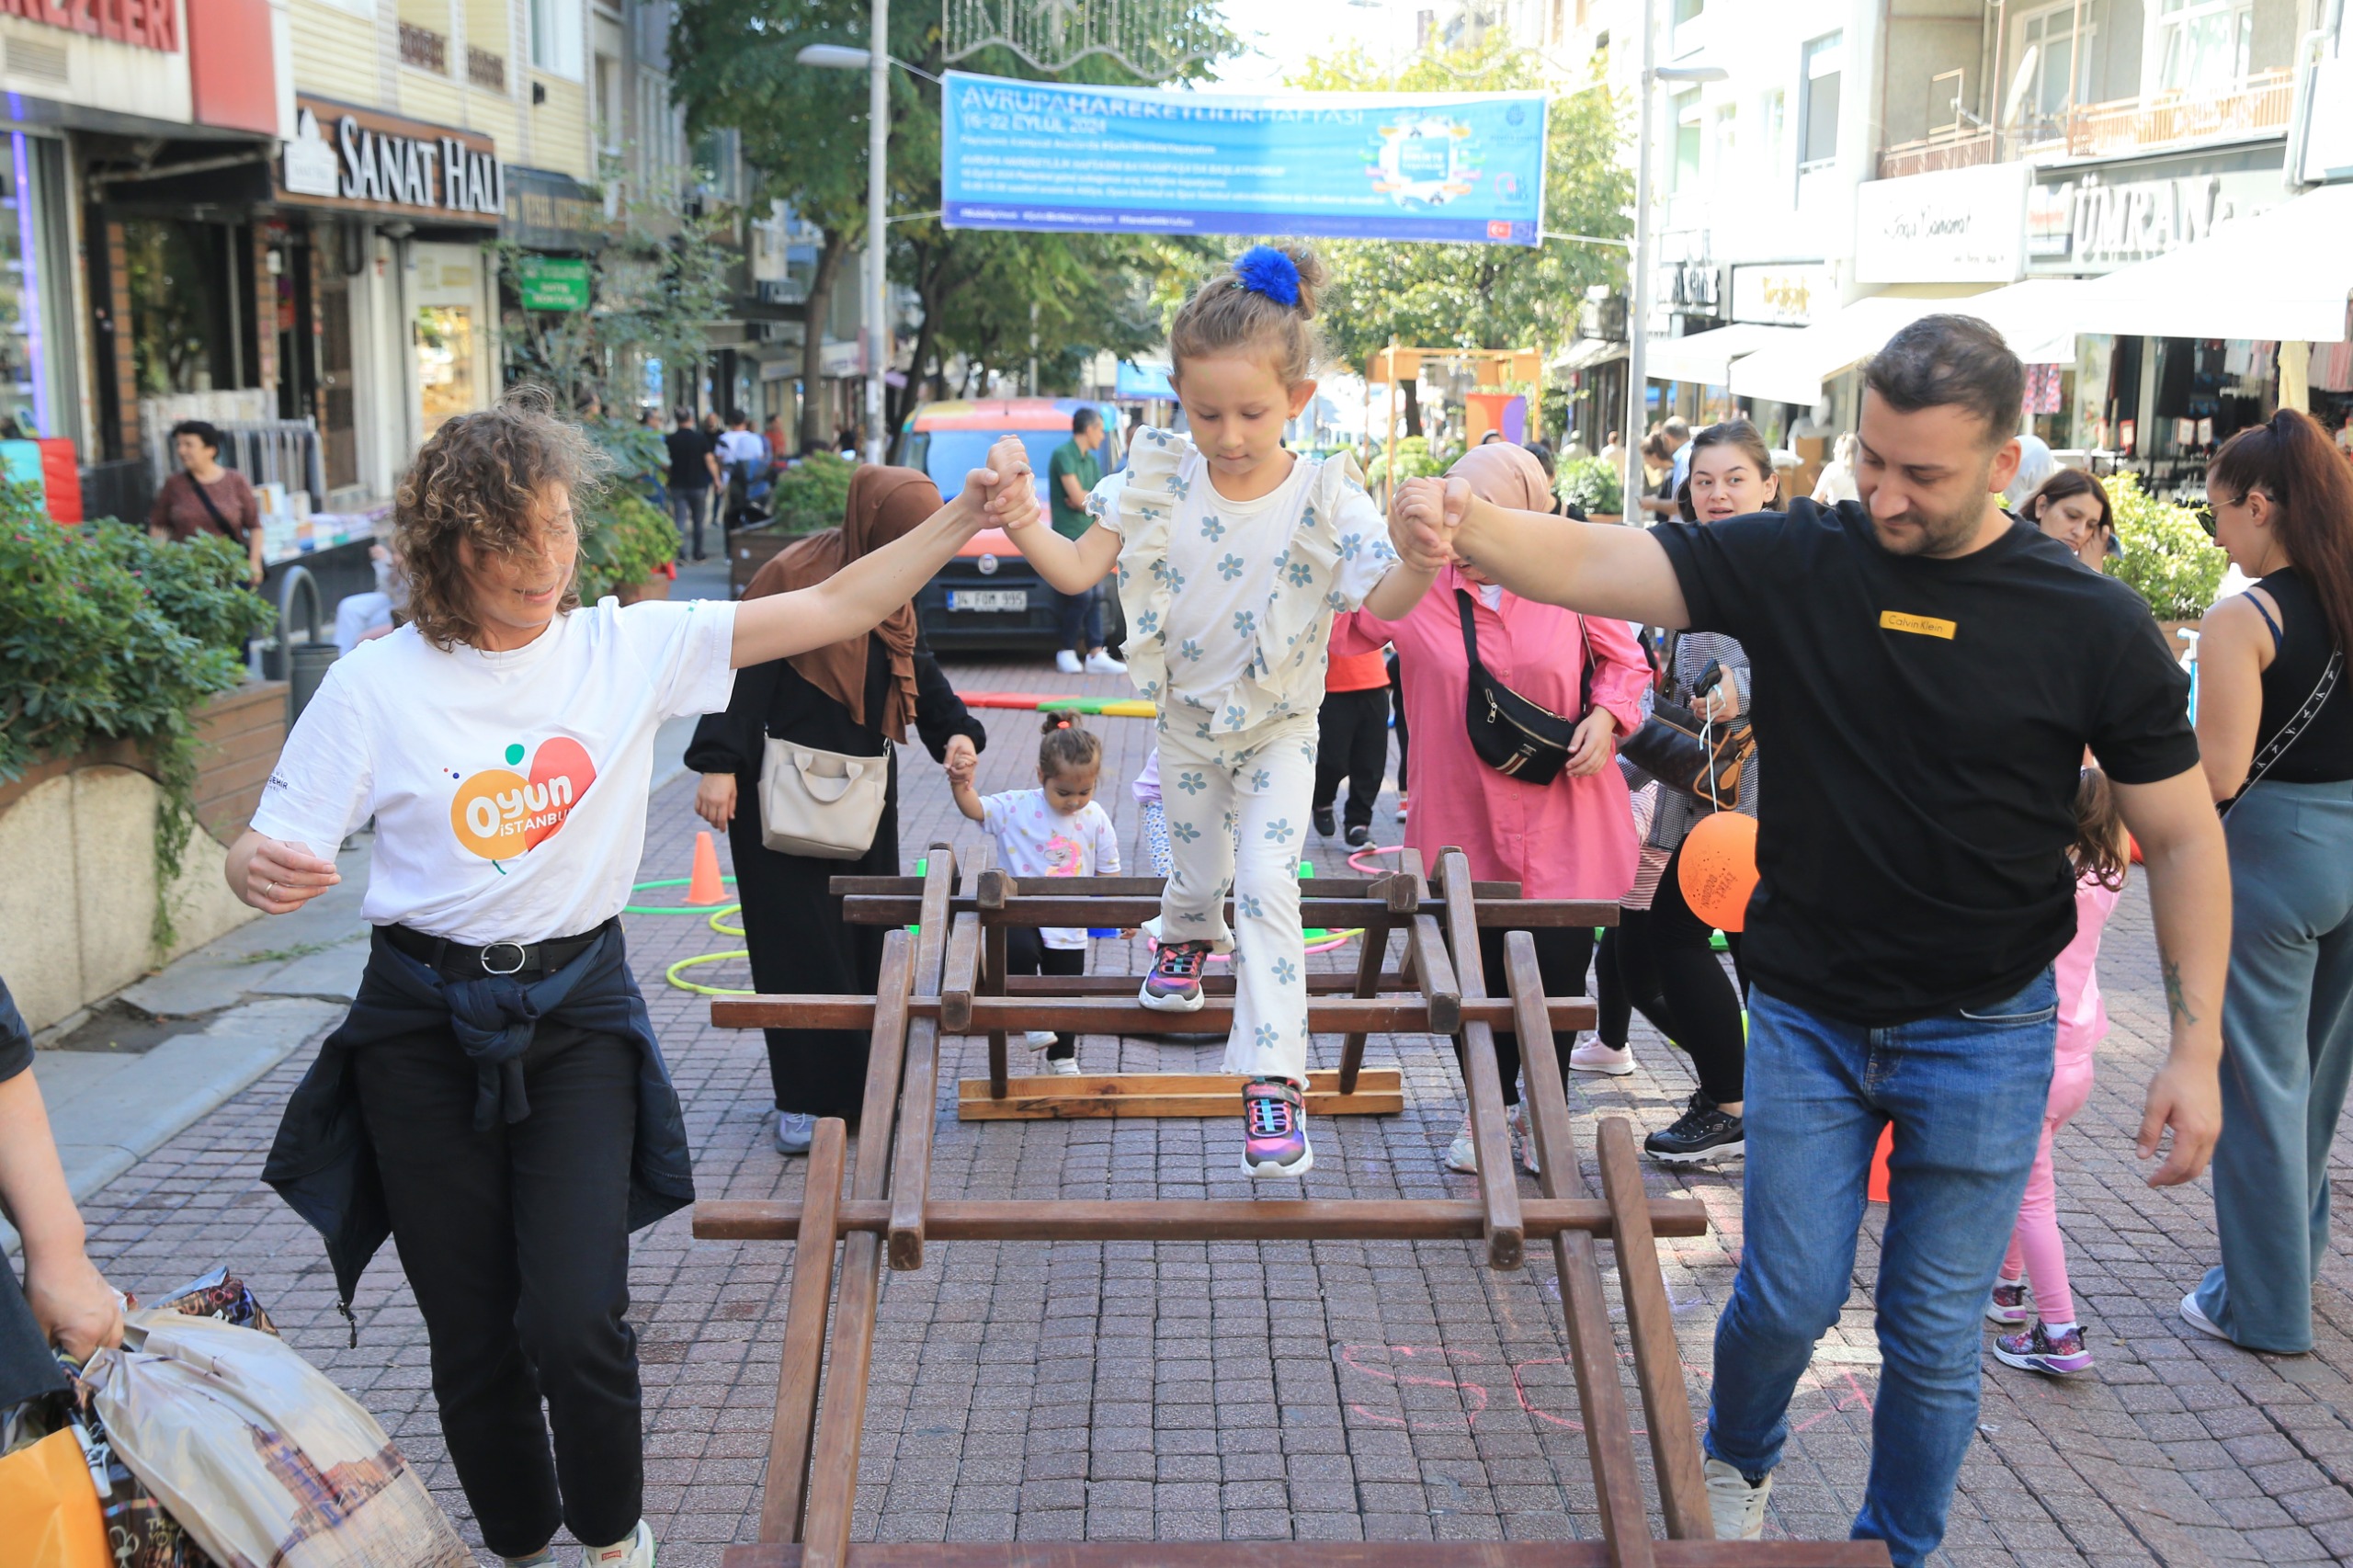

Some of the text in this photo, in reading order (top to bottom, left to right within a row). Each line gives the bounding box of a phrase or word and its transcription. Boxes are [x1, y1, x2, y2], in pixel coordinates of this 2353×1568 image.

[340, 115, 438, 208] SANAT
[1888, 615, 1943, 633] Calvin Klein
[466, 775, 573, 838] Oyun
[500, 807, 572, 836] iSTANBU
